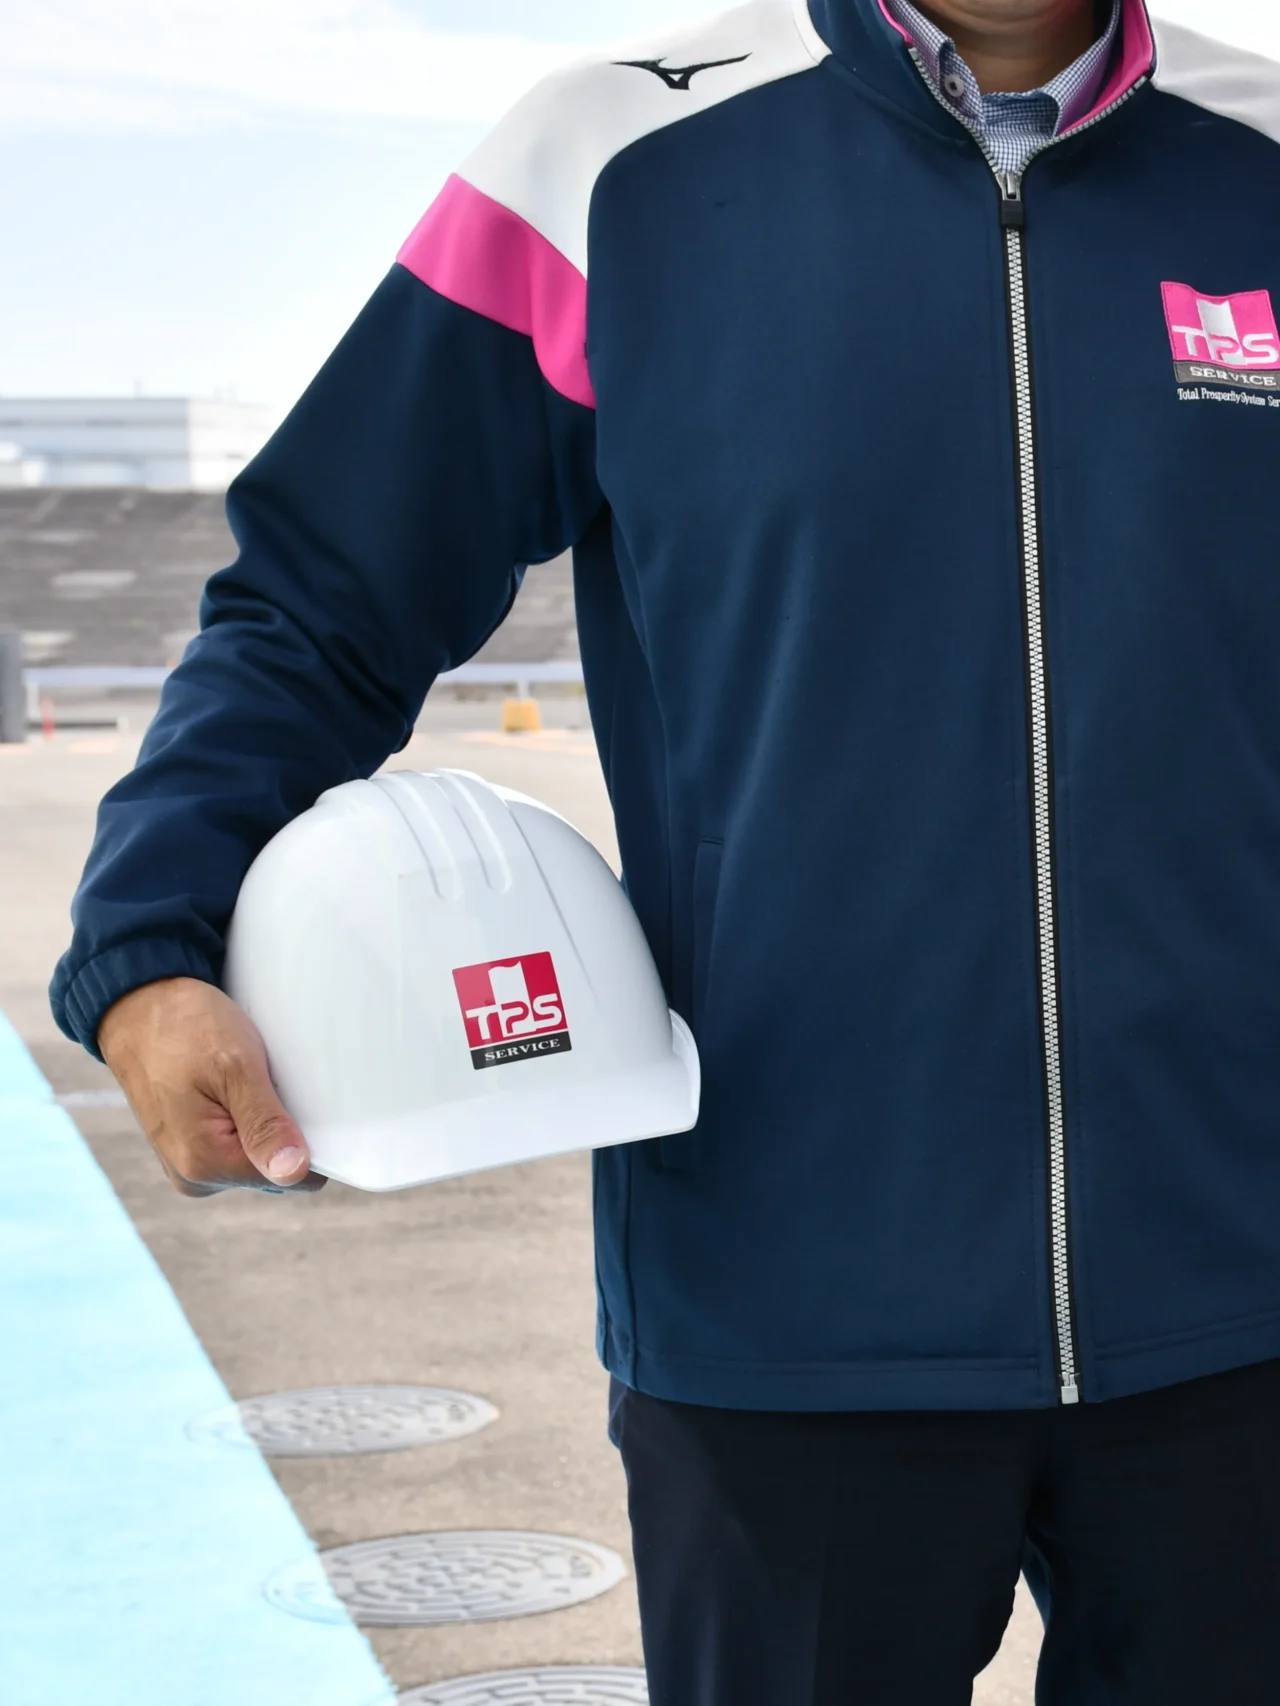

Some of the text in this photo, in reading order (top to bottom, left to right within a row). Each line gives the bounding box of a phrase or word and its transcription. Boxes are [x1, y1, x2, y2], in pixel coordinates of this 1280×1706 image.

[1171, 325, 1280, 366] TPS
[1189, 366, 1277, 387] SERVICE
[1177, 387, 1200, 401] Total
[465, 993, 563, 1040] TPS
[484, 1038, 560, 1061] SERVICE
